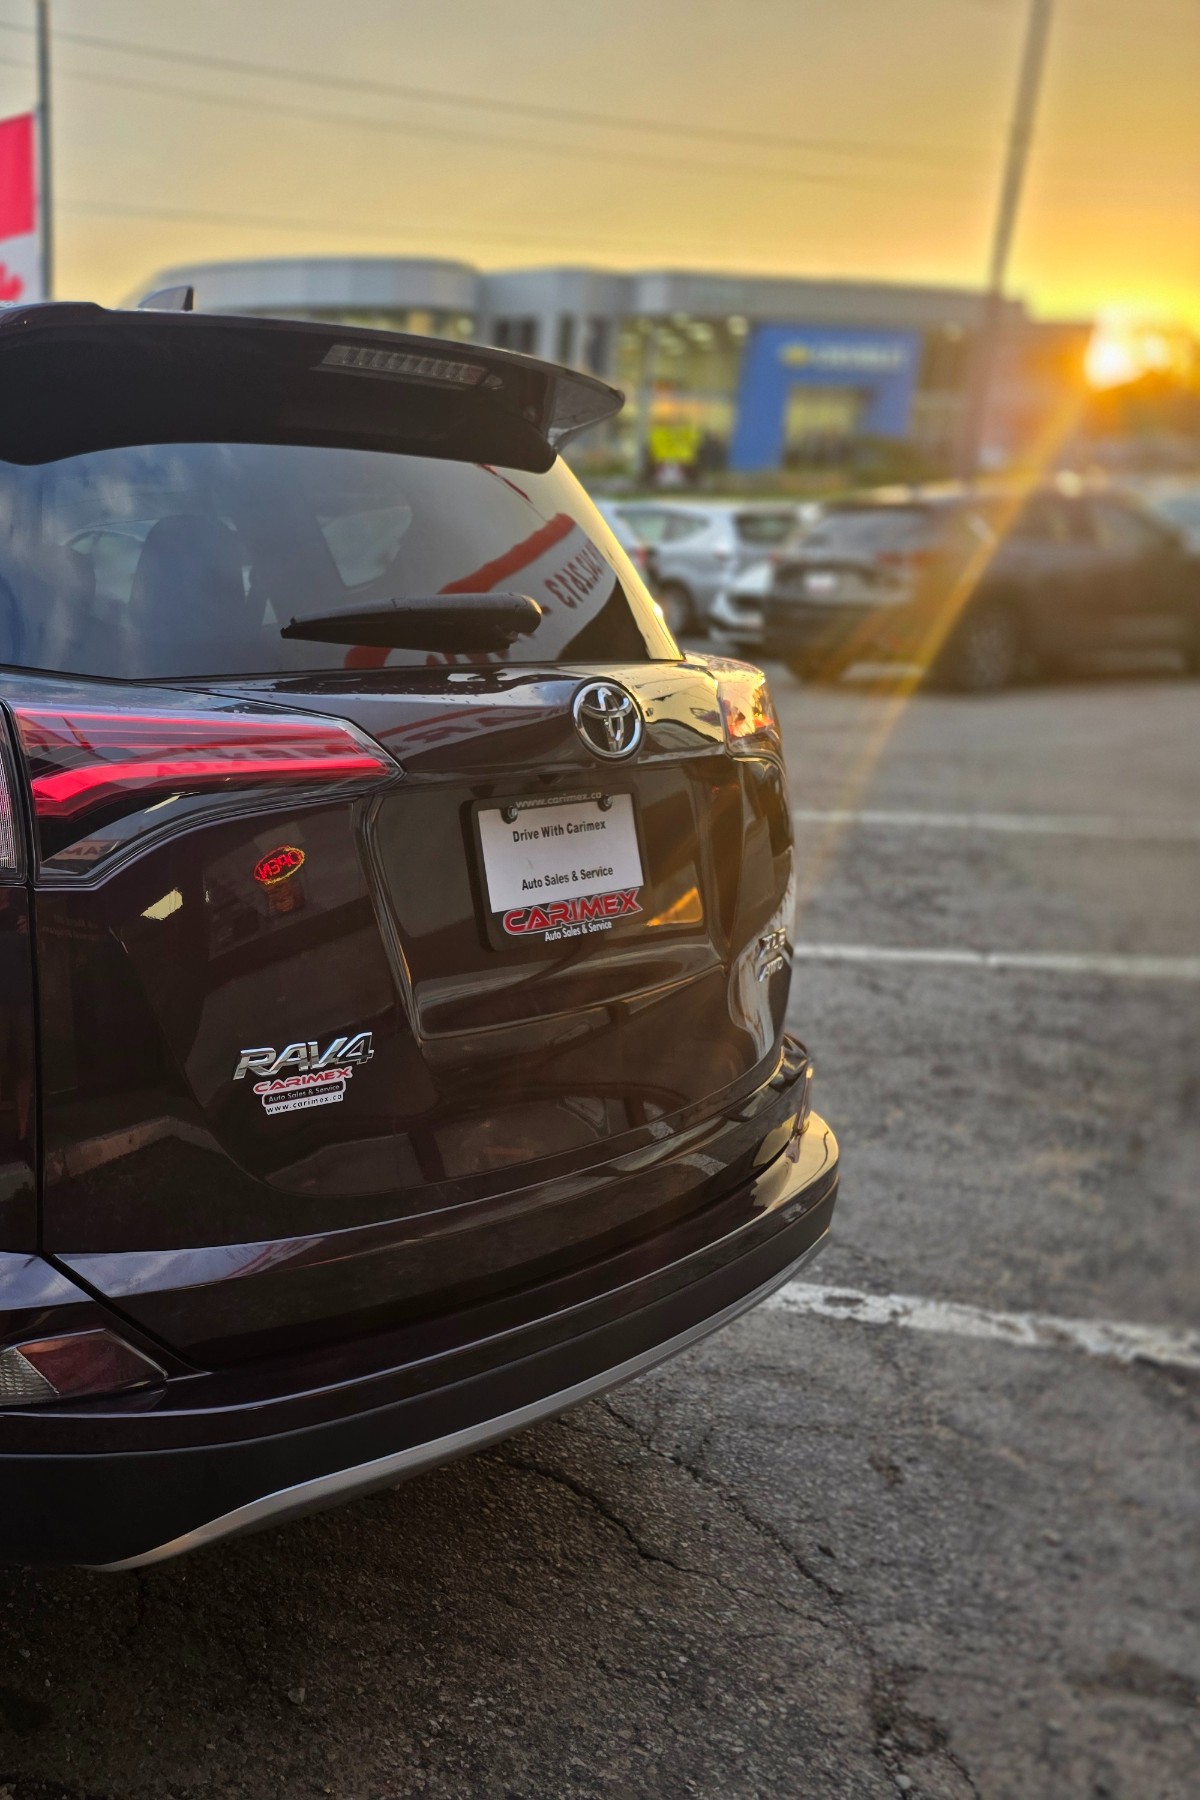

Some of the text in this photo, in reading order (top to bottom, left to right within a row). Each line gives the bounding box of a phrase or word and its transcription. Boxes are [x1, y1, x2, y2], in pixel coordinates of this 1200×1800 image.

[515, 792, 602, 808] www.carimex.ca
[512, 820, 606, 842] Drive With Carimex
[522, 866, 614, 890] Auto Sales & Service
[503, 888, 641, 934] CARIMEX
[544, 920, 612, 941] Auto Sales & Service
[232, 1031, 375, 1080] RAV4
[254, 1068, 350, 1092] CARIMEX
[267, 1094, 342, 1113] www.carimex.ca
[268, 1094, 286, 1103] Auto
[288, 1090, 307, 1099] Sales
[315, 1085, 340, 1094] Service
